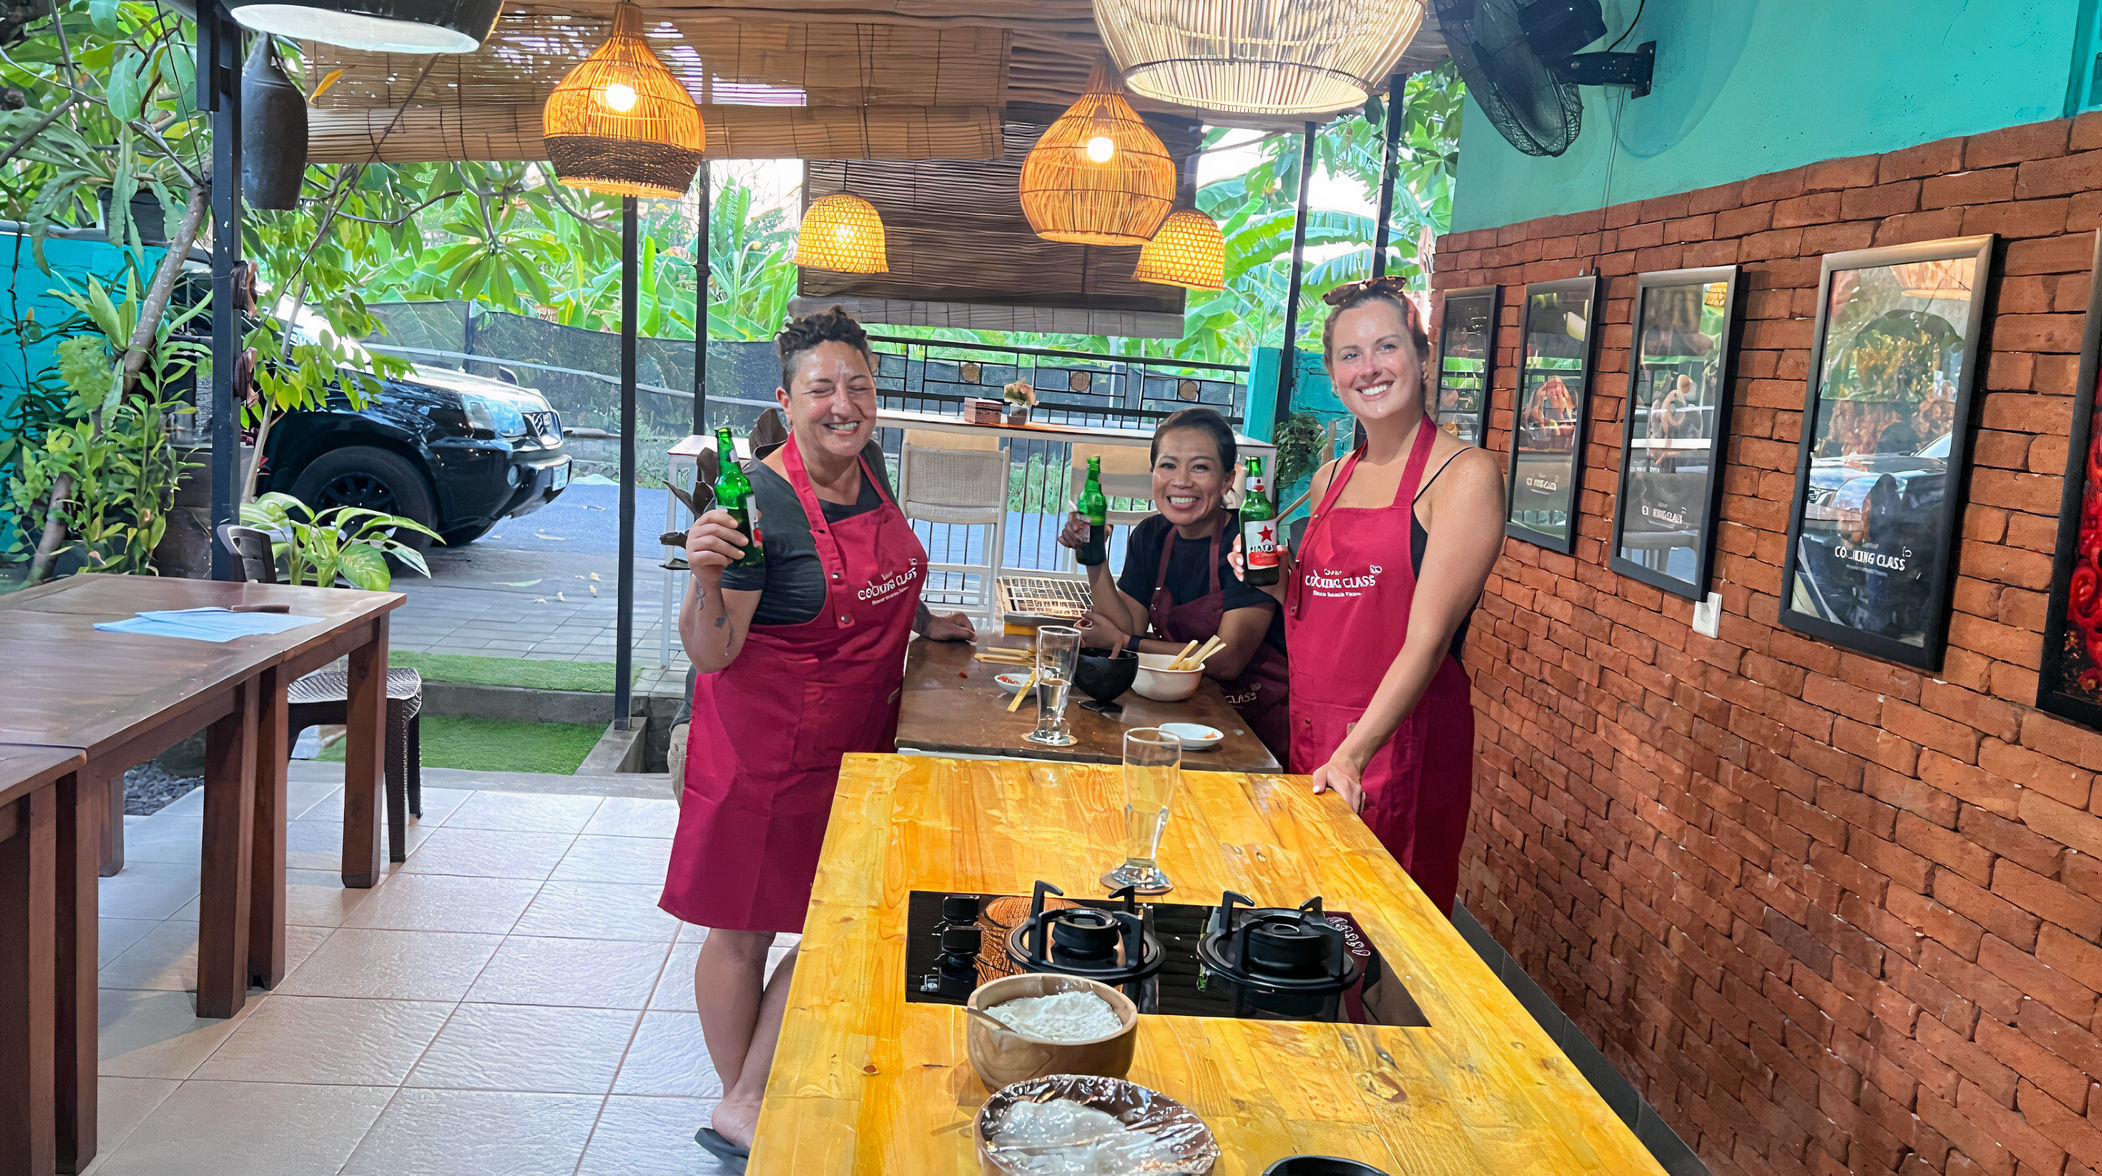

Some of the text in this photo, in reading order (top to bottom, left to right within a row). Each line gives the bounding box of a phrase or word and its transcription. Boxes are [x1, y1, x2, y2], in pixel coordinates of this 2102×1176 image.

[1834, 546, 1876, 565] COKING
[1876, 554, 1906, 572] CLASS
[1342, 574, 1376, 589] CLASS
